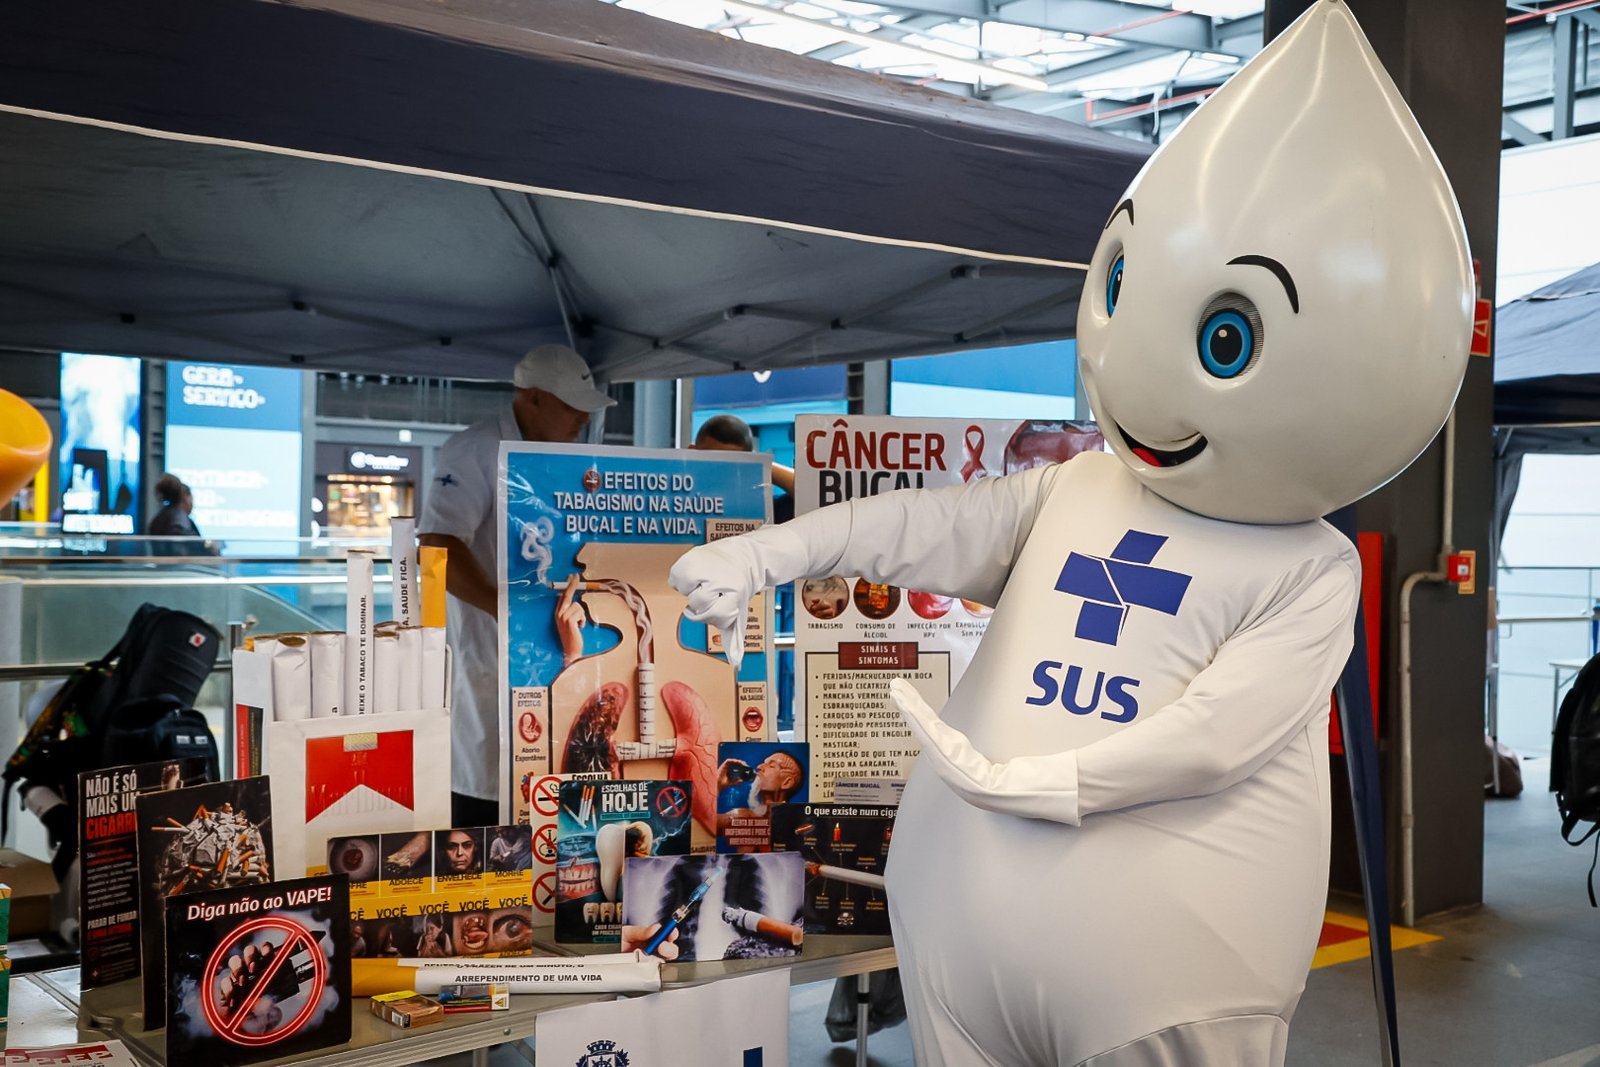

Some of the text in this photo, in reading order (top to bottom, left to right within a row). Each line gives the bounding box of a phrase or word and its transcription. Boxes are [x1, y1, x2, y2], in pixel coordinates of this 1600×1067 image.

[806, 419, 947, 471] CÂNCER
[604, 471, 694, 491] EFEITOS DO
[554, 491, 724, 513] TABAGISMO NA SAÚDE
[566, 515, 702, 535] BUCAL E NA VIDA.
[715, 523, 755, 531] EFEITOS NA
[360, 637, 366, 647] TE
[891, 645, 897, 653] E
[858, 656, 899, 665] SINTOMAS
[1025, 660, 1140, 723] SUS
[823, 712, 854, 720] CAROÇOS
[823, 750, 859, 759] SENSAÇÃO
[86, 769, 137, 797] NÃO É SÓ
[823, 770, 868, 778] DIFICULDADE
[601, 782, 649, 793] ESCOLHAS DE
[86, 795, 118, 818] MAIS
[602, 792, 649, 812] HOJE
[805, 805, 811, 816] O
[813, 808, 830, 817] que
[831, 806, 858, 816] existe
[86, 812, 138, 839] CIGARR
[187, 886, 332, 921] Diga não ao VAPE!
[350, 894, 529, 921] CÊ VOCÊ VOCÊ VOCÊ VOCÊ
[455, 974, 602, 982] ARREPENDIMENTO DE UMA VIDA
